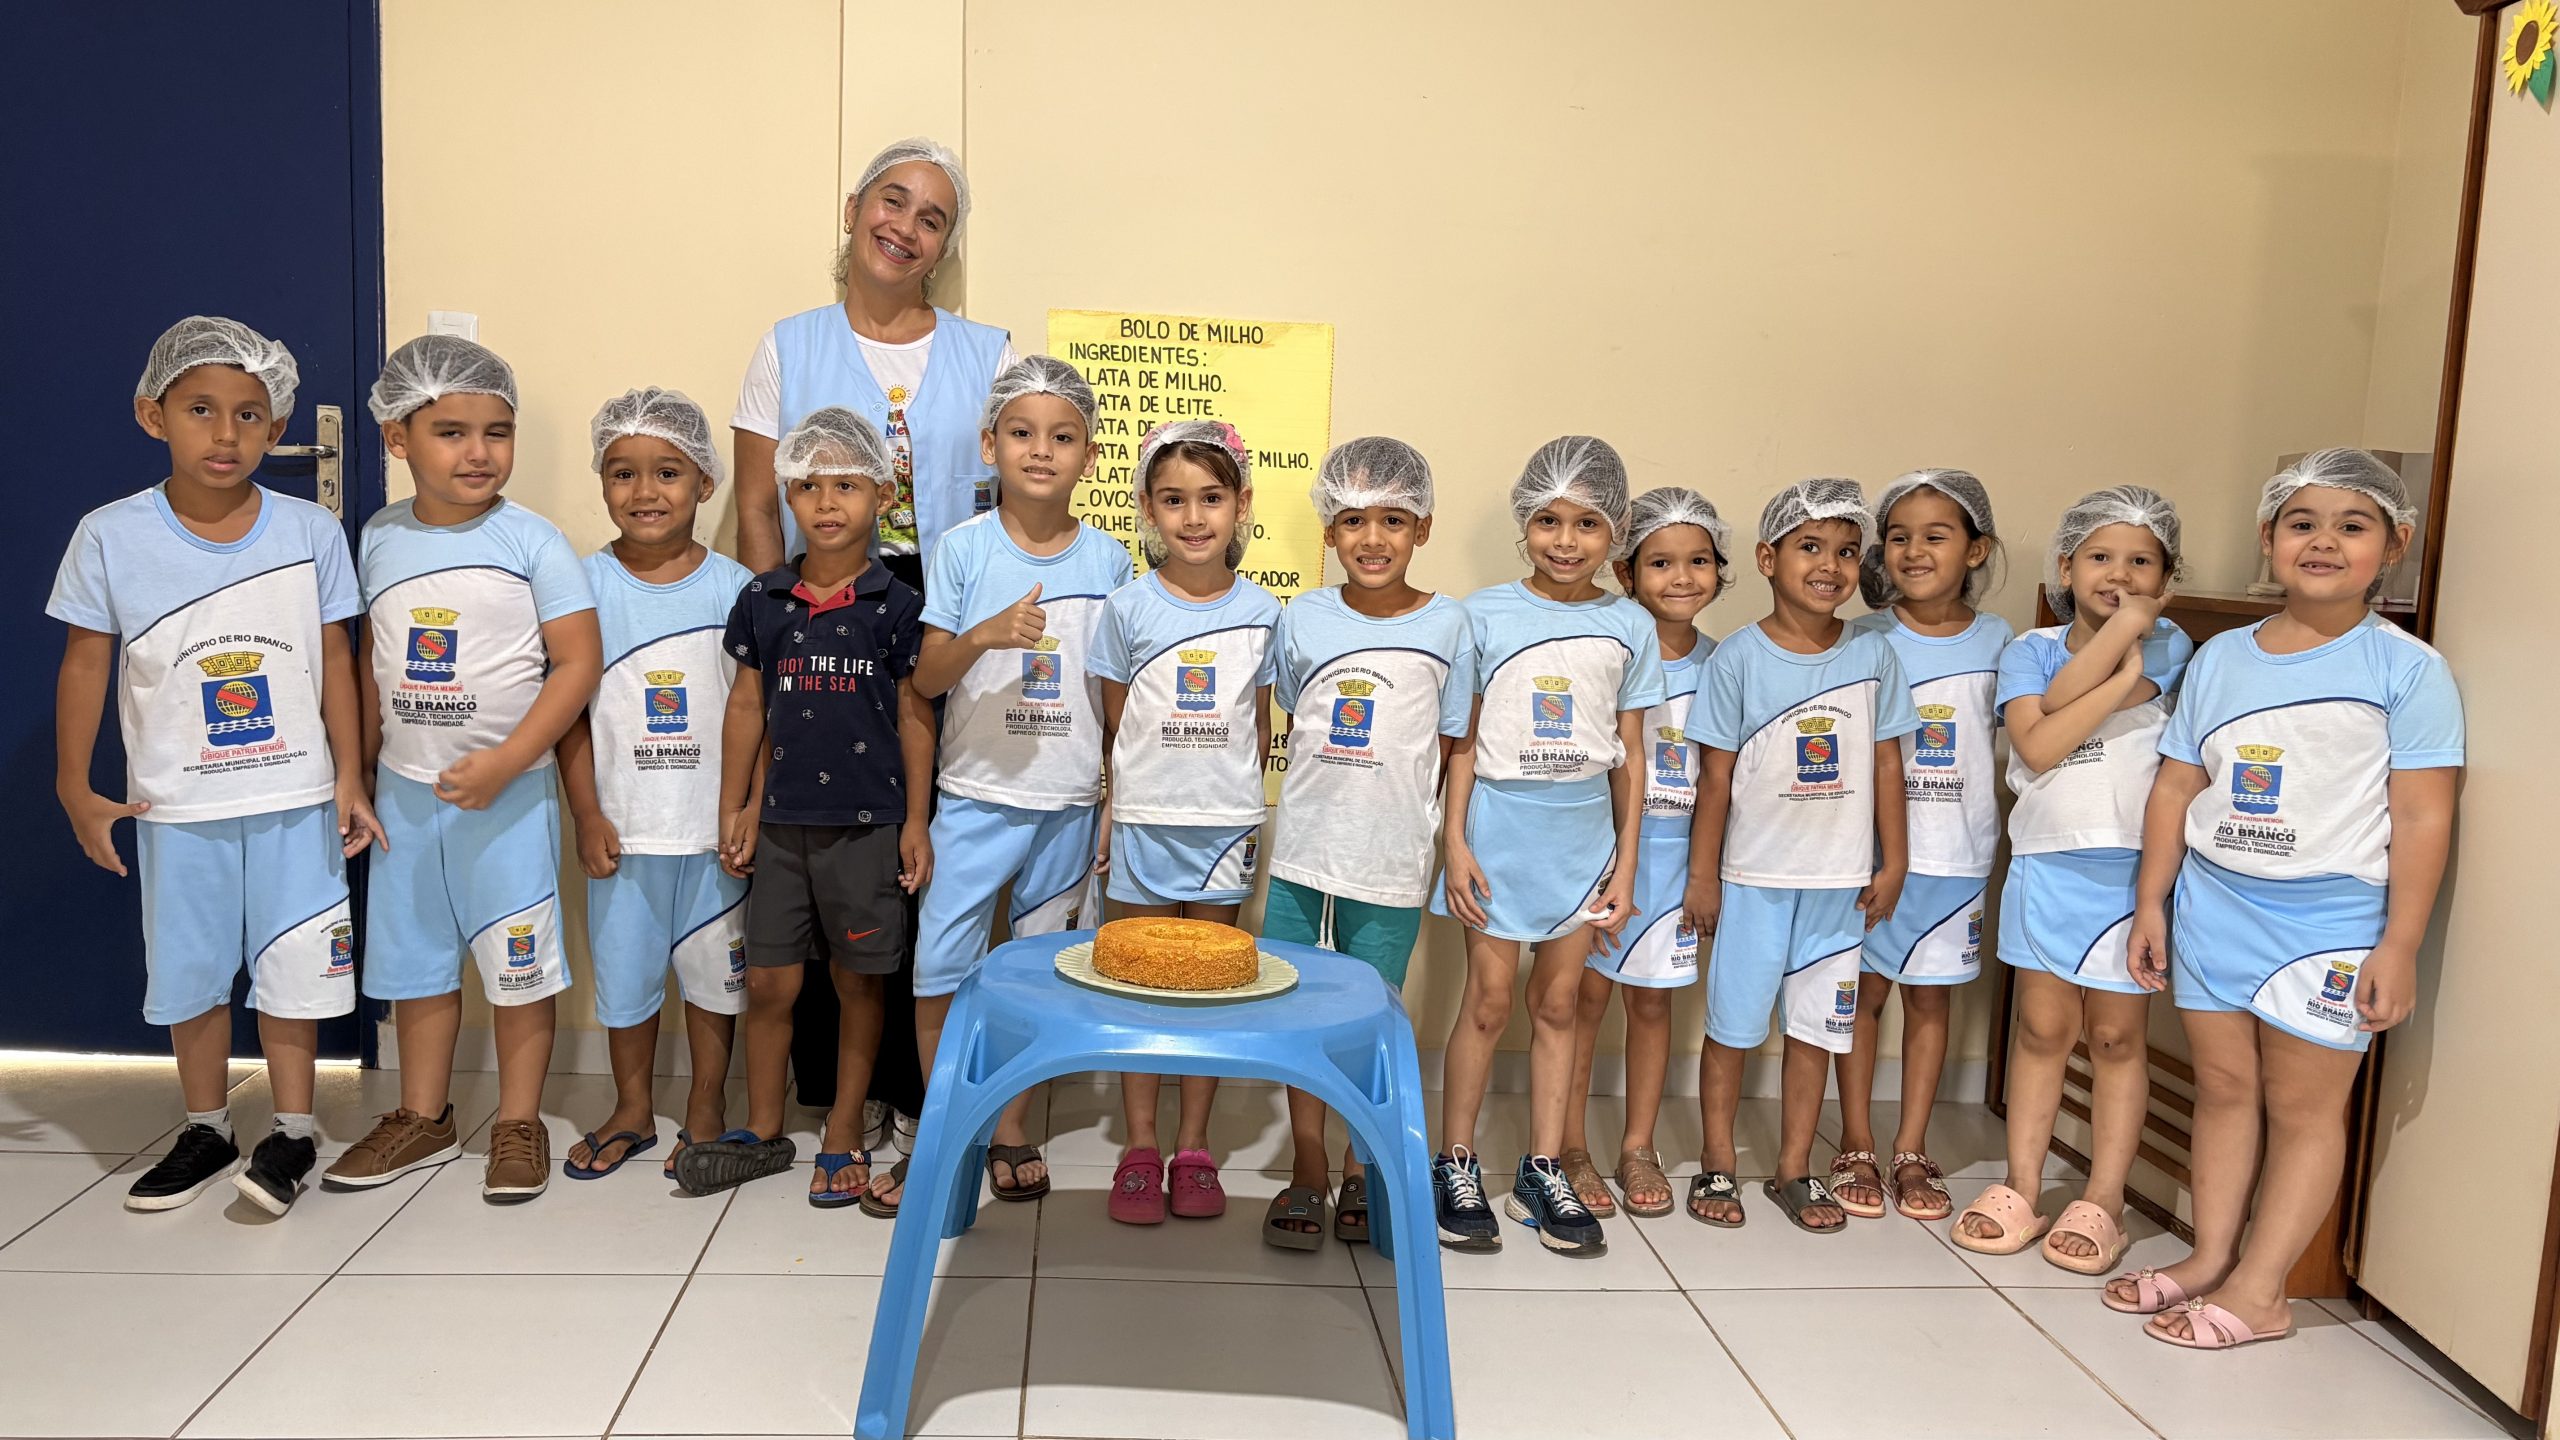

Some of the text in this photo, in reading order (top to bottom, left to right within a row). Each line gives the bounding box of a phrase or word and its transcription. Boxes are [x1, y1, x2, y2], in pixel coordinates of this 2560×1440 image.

[1120, 319, 1264, 345] BOLO DE MILHO
[1069, 342, 1208, 368] INGREDIENTES:
[1086, 367, 1227, 393] LATA DE MILHO.
[1098, 393, 1132, 412] ATA
[1140, 395, 1160, 413] DE
[1095, 418, 1130, 436] ATA
[1096, 443, 1130, 461] ATA
[1259, 451, 1314, 471] MILHO.
[173, 634, 294, 669] MUNICÍPIO DE RIO BRANCO
[810, 655, 837, 672] THE
[844, 657, 874, 676] LIFE
[779, 675, 856, 692] IN THE SEA
[1320, 666, 1351, 684] MUNICÍPIO
[1360, 667, 1371, 675] RIO
[1372, 670, 1395, 690] BRANCO
[392, 690, 457, 701] PREFEITURA
[392, 698, 477, 711] RIO BRANCO
[1006, 713, 1072, 724] RIO BRANCO
[1828, 705, 1852, 719] BRANCO
[1162, 727, 1230, 735] RIO BRANCO
[202, 743, 285, 761] UBIQUE PATRIA MEMOR
[634, 748, 701, 758] RIO BRANCO
[1520, 753, 1590, 763] RIO BRANCO
[183, 750, 308, 773] SECRETARIA MUNICIPAL DE EDUCAÇÃO
[1923, 781, 1964, 790] BRANCO
[2238, 828, 2296, 843] BRANCO
